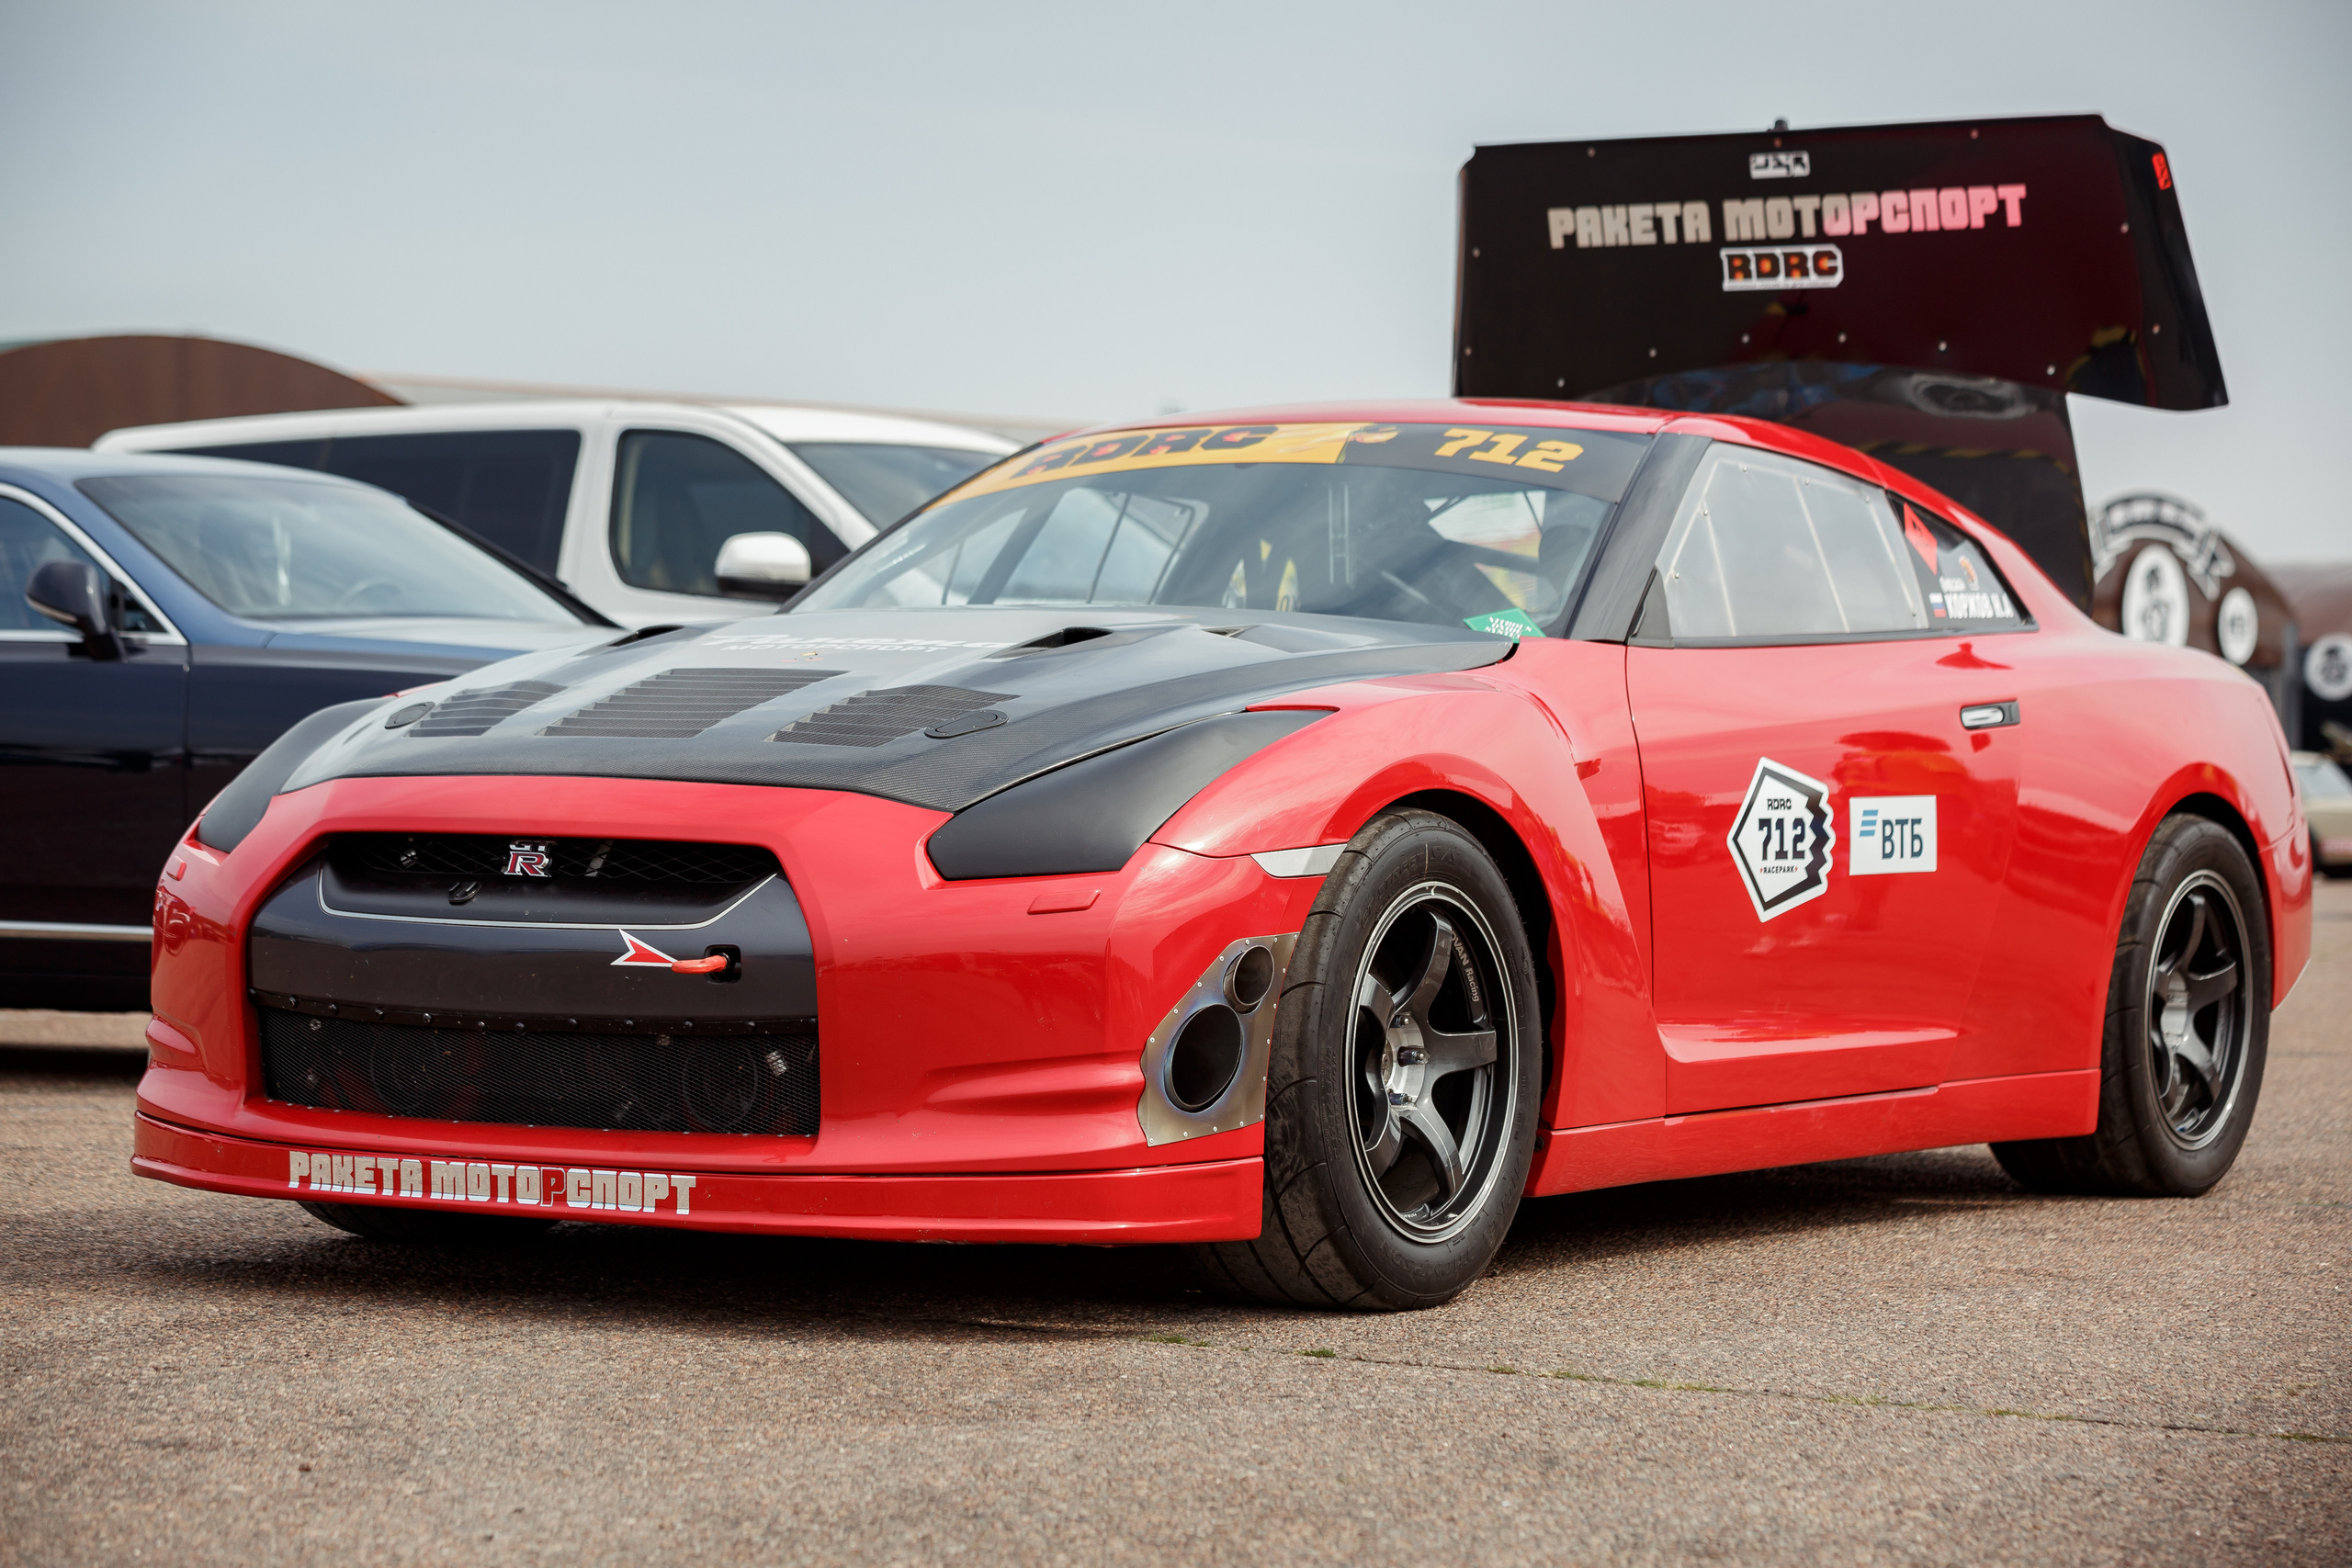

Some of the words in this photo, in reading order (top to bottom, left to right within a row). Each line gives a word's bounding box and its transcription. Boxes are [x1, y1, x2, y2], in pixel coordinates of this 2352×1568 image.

[1547, 200, 1712, 249] РАКЕТА
[1722, 184, 2026, 242] МОТОРСПОРТ
[1723, 245, 1841, 284] RDRC
[1435, 426, 1585, 474] 712
[1767, 798, 1792, 811] RDRC
[1758, 818, 1806, 862] 712
[1882, 818, 1923, 860] ВТБ
[1762, 865, 1795, 874] RACEPARK
[1451, 930, 1470, 966] DVAN
[1464, 967, 1480, 1003] Racing
[288, 1151, 423, 1198] РАКЕТА
[430, 1160, 696, 1215] МОТОРСПОРТ
